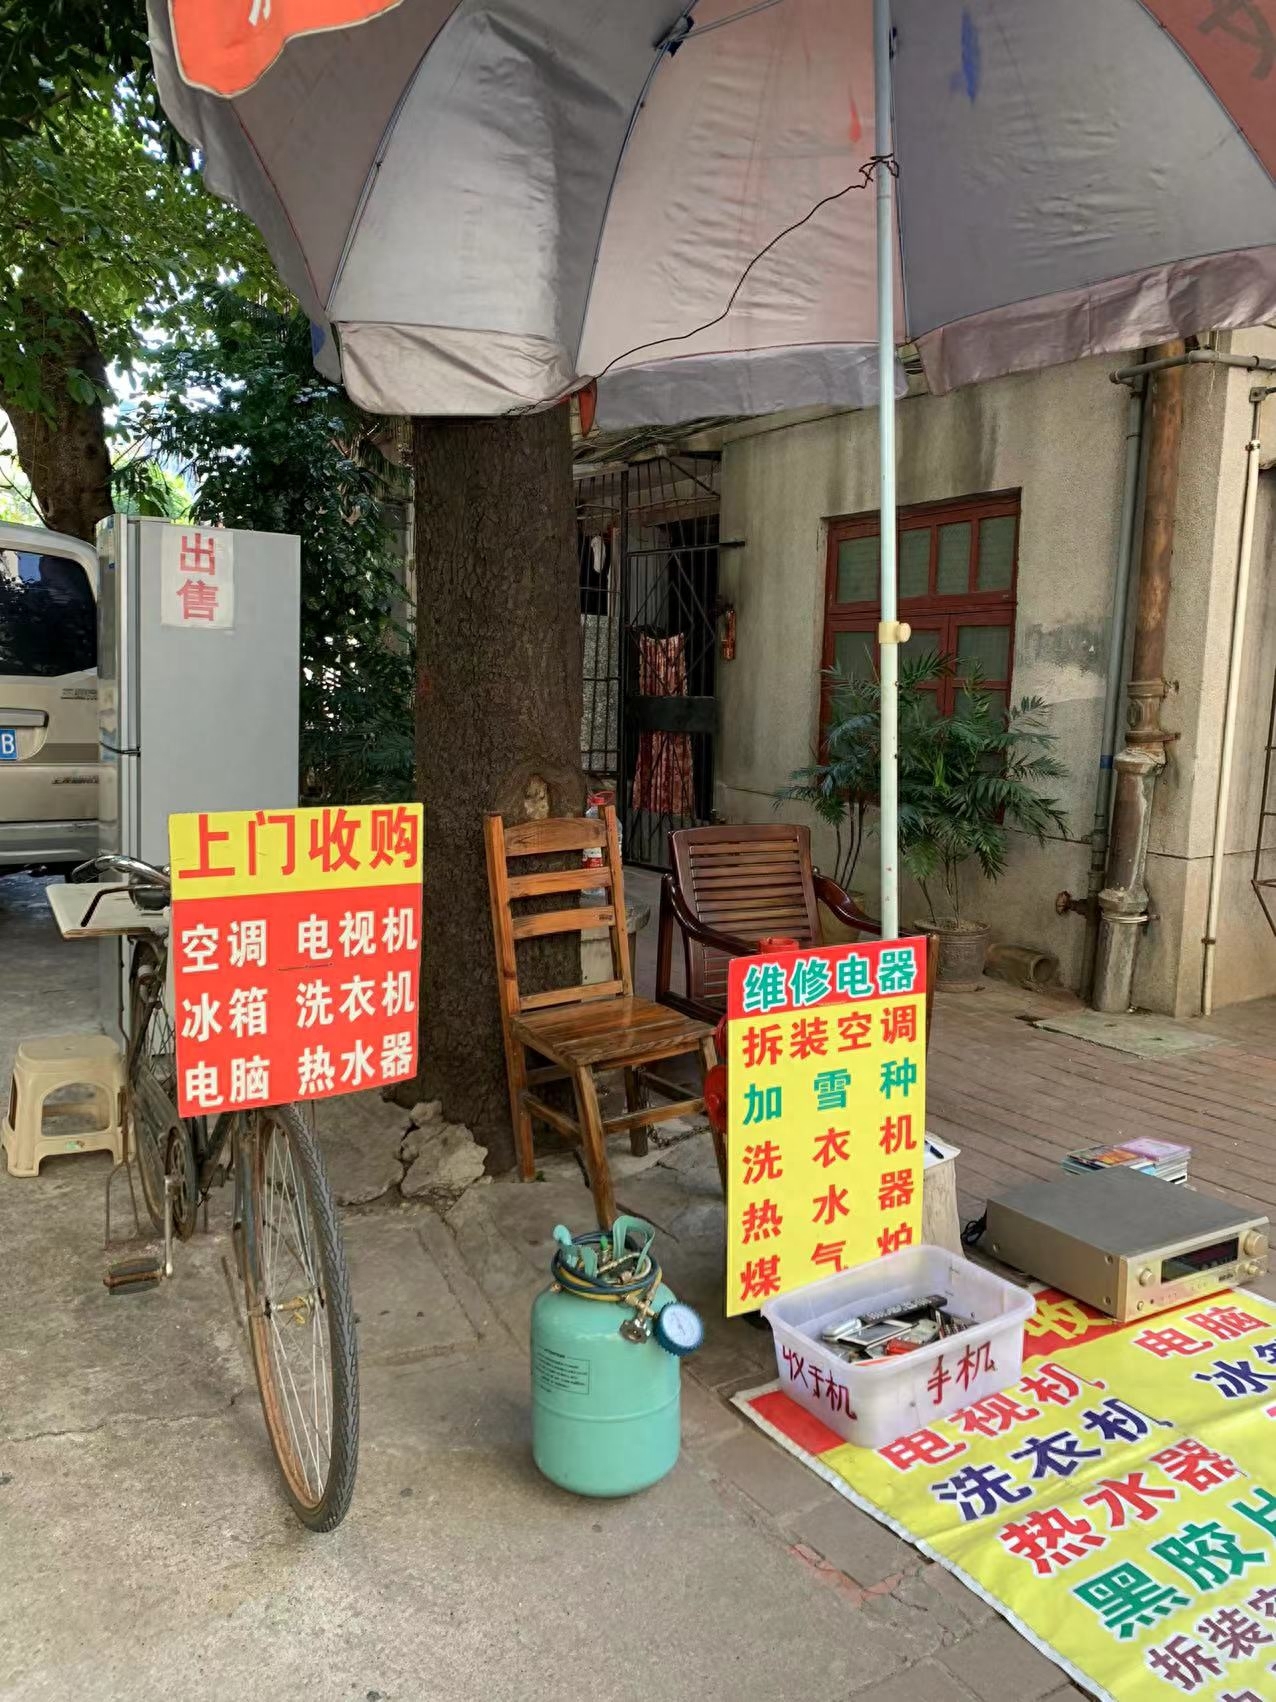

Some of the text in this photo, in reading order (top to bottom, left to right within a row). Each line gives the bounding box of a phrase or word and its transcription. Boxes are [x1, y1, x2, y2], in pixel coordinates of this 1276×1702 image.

[176, 533, 219, 621] 出售
[178, 806, 419, 880] 上门收购
[181, 906, 418, 974] 空调 电视机
[181, 970, 416, 1042] 冰箱 洗衣机
[742, 948, 917, 1012] 维修电器
[185, 1031, 414, 1108] 电脑 热水器
[741, 1004, 917, 1068] 拆装空调
[782, 1345, 858, 1420] 收手机
[877, 1305, 1272, 1472] 电视机 电脑
[927, 1340, 998, 1405] 手机
[930, 1397, 1175, 1521] 洗衣机
[999, 1438, 1240, 1575] 热水器
